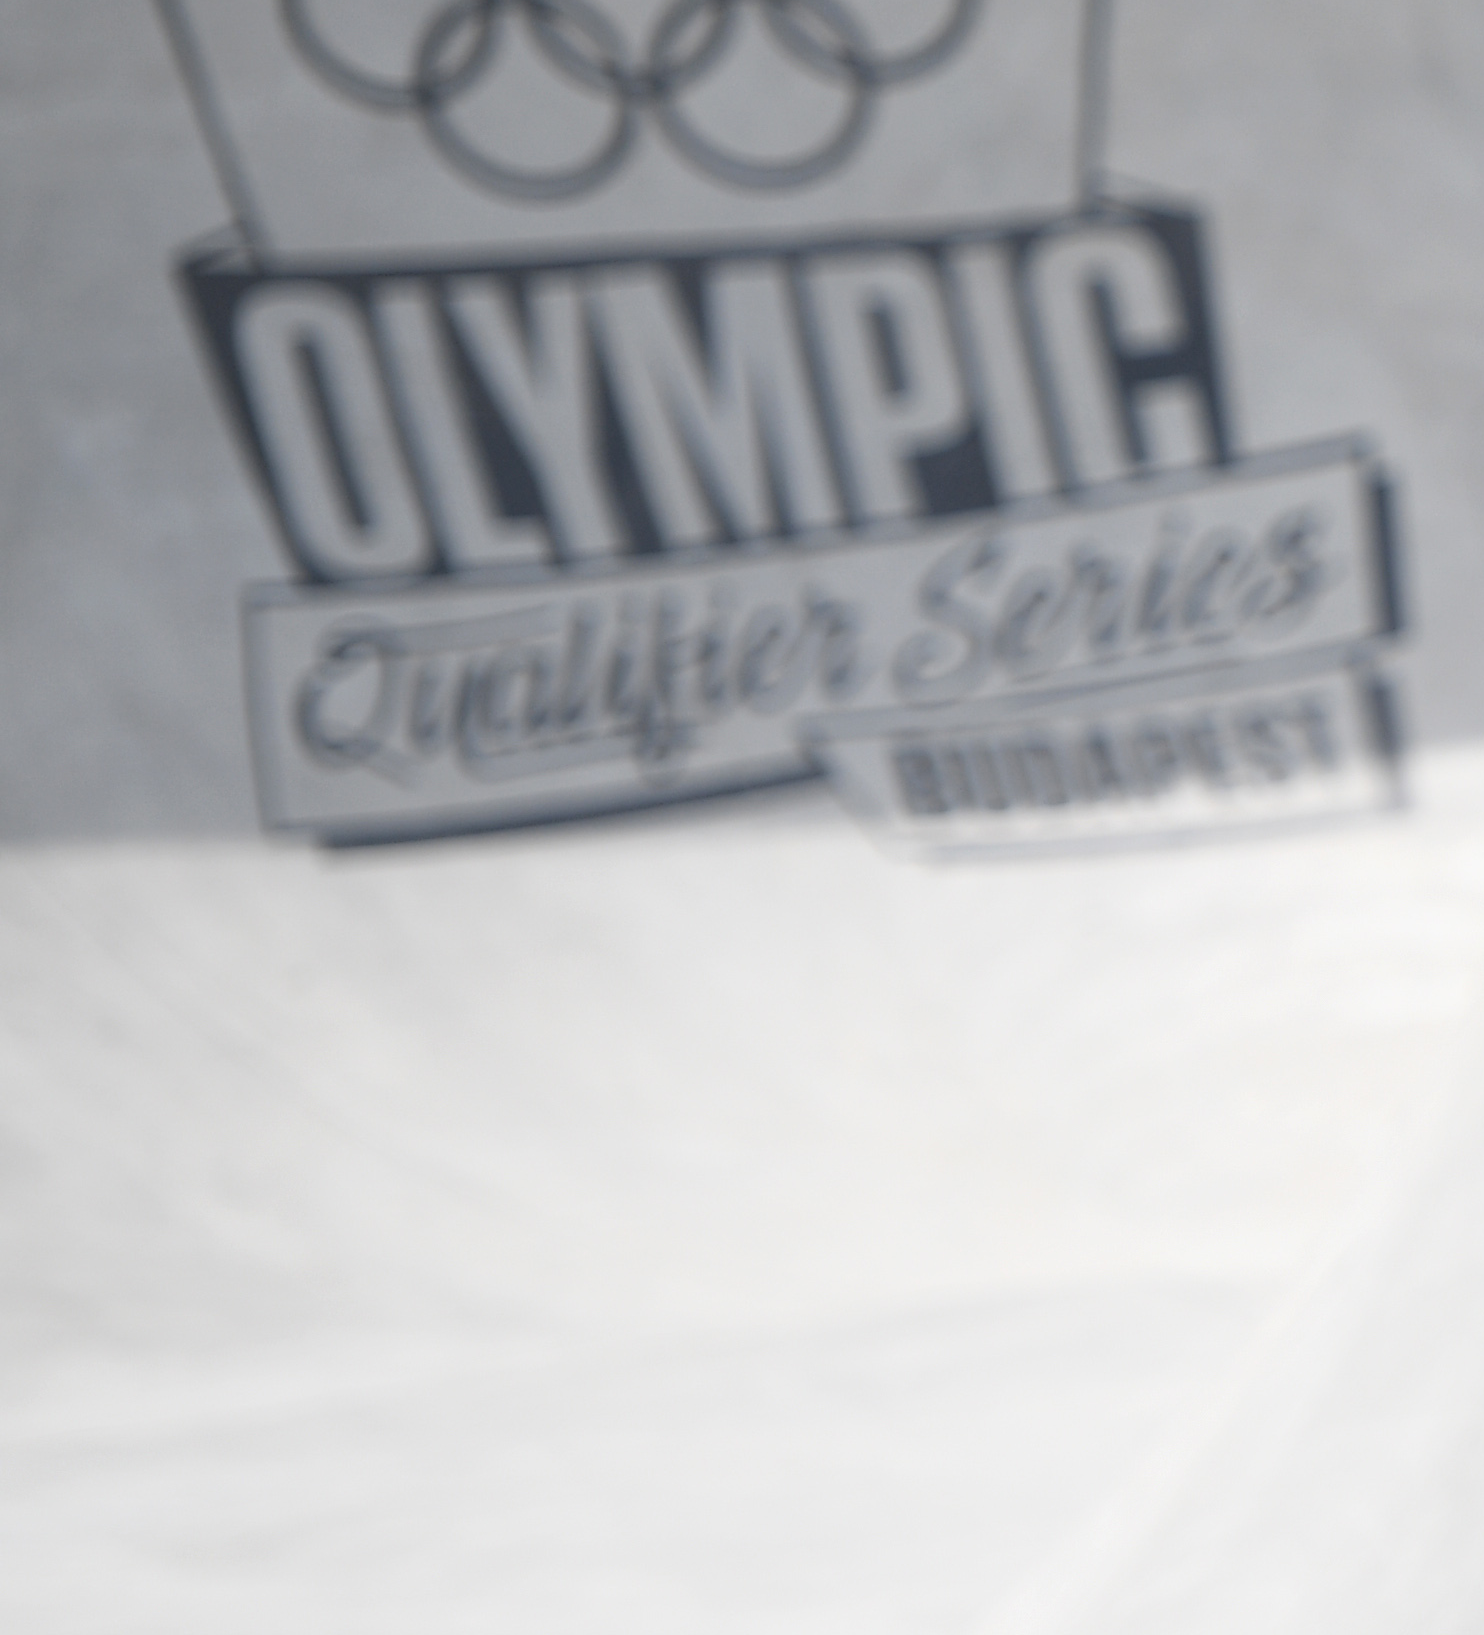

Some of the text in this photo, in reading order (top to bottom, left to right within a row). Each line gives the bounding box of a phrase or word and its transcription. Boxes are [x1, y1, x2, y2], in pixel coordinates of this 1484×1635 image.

[232, 219, 1193, 572] OLYMPIC
[296, 497, 1338, 786] Qualifier Series
[889, 690, 1340, 818] BUDAPEST
